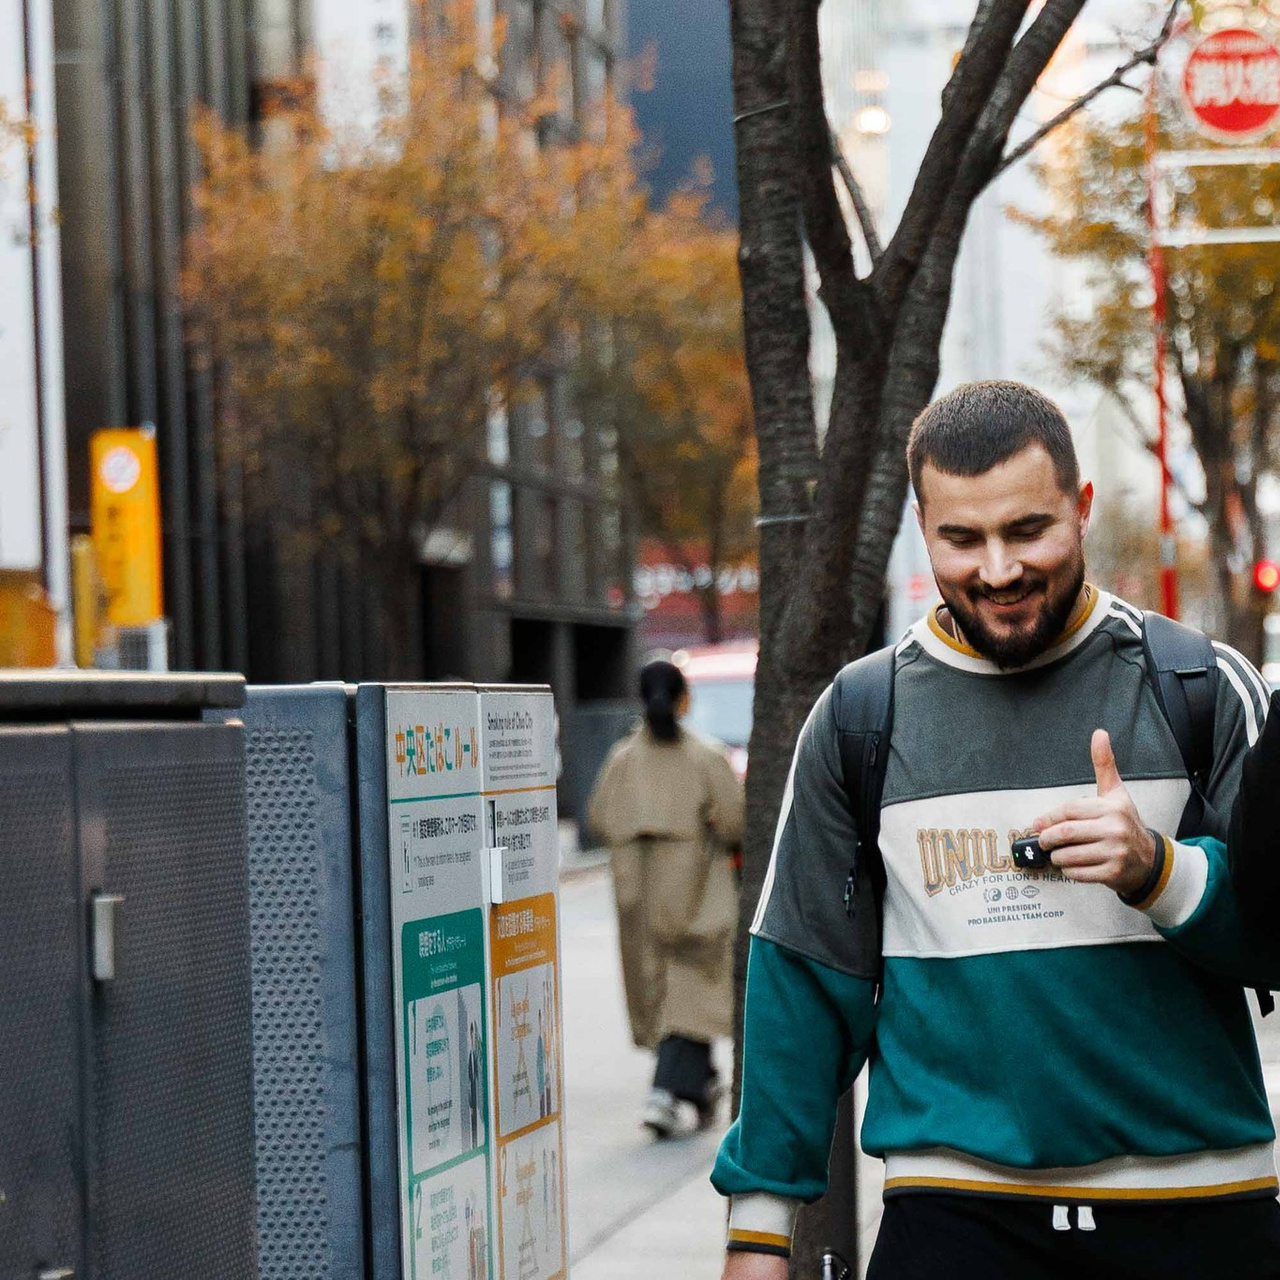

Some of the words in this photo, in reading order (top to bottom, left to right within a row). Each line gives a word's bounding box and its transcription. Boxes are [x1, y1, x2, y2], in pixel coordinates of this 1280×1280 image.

[948, 878, 981, 896] CRAZY
[982, 874, 1004, 886] FOR
[1006, 872, 1040, 884] LION'S
[987, 906, 1001, 914] UNI
[1002, 902, 1042, 913] PRESIDENT
[967, 916, 983, 926] PRO
[983, 912, 1021, 924] BASEBALL
[1021, 910, 1043, 921] TEAM
[1043, 909, 1065, 919] CORP
